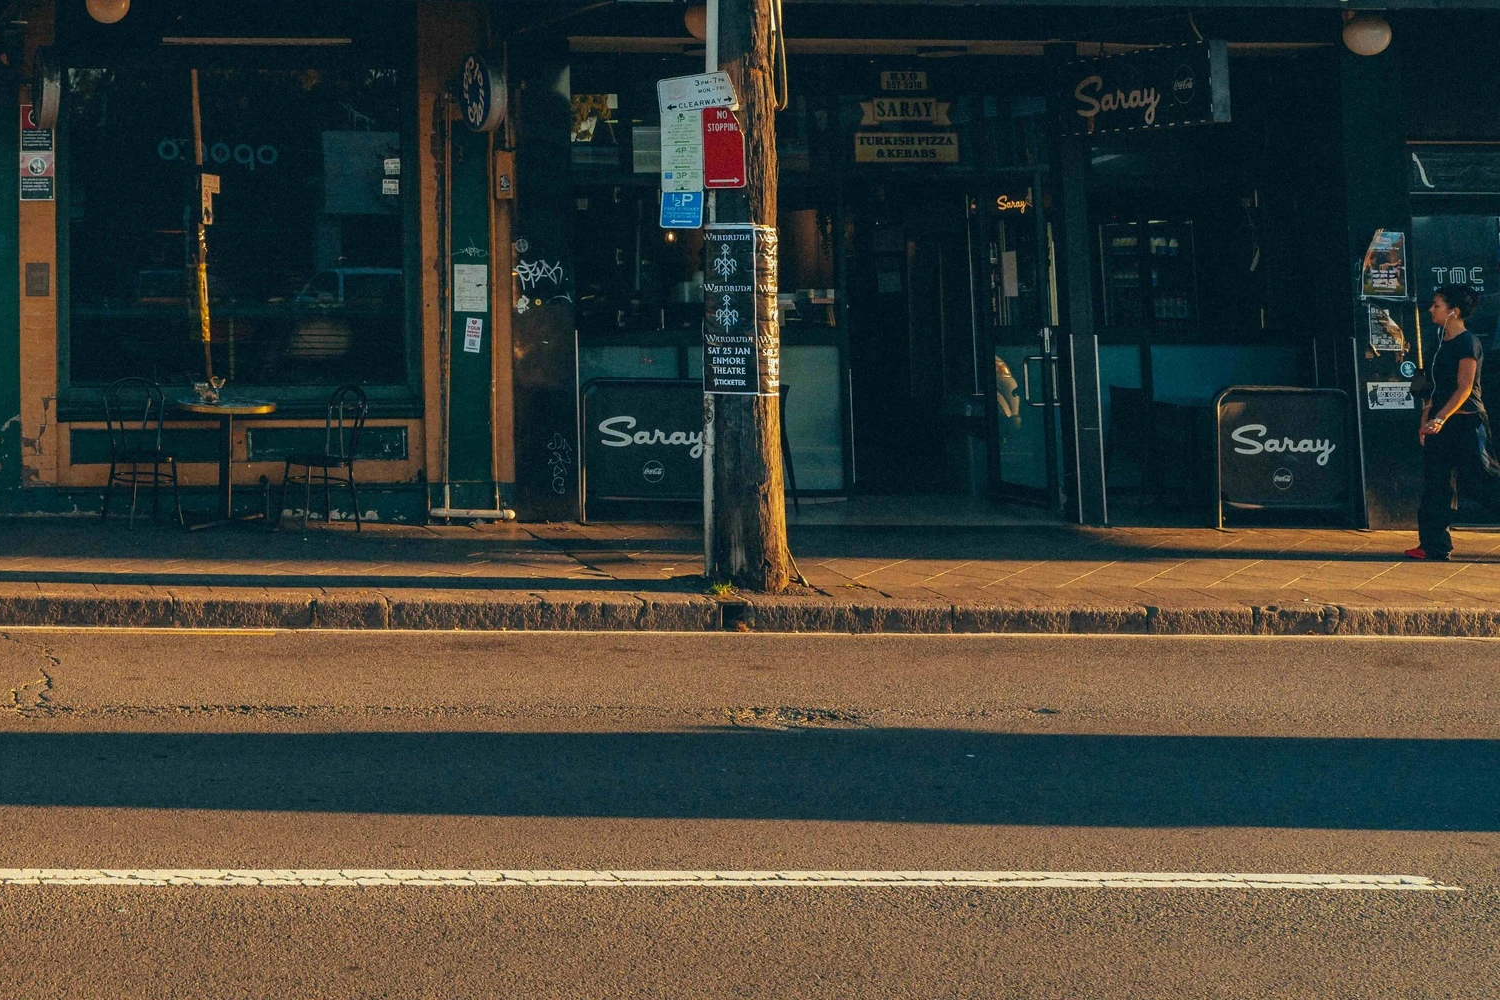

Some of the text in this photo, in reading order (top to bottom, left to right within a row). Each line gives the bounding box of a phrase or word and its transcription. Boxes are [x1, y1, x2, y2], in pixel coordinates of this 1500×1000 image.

[678, 97, 722, 108] CLEARWAY
[1075, 75, 1160, 125] Saray
[876, 101, 933, 117] SARAY
[716, 110, 728, 119] NO
[707, 123, 738, 132] STOPPING
[857, 136, 954, 146] TURKISH PIZZA
[887, 149, 937, 158] KEBABS
[997, 195, 1027, 214] Saray
[1431, 267, 1484, 284] TMC
[704, 283, 752, 292] WARDRUNA
[705, 334, 753, 343] WARDRUNA
[707, 347, 751, 355] SAT 25 JAN
[712, 357, 746, 365] ENMORE
[712, 367, 746, 375] THEATRE
[598, 416, 705, 459] Saray
[1231, 424, 1336, 466] Saray
